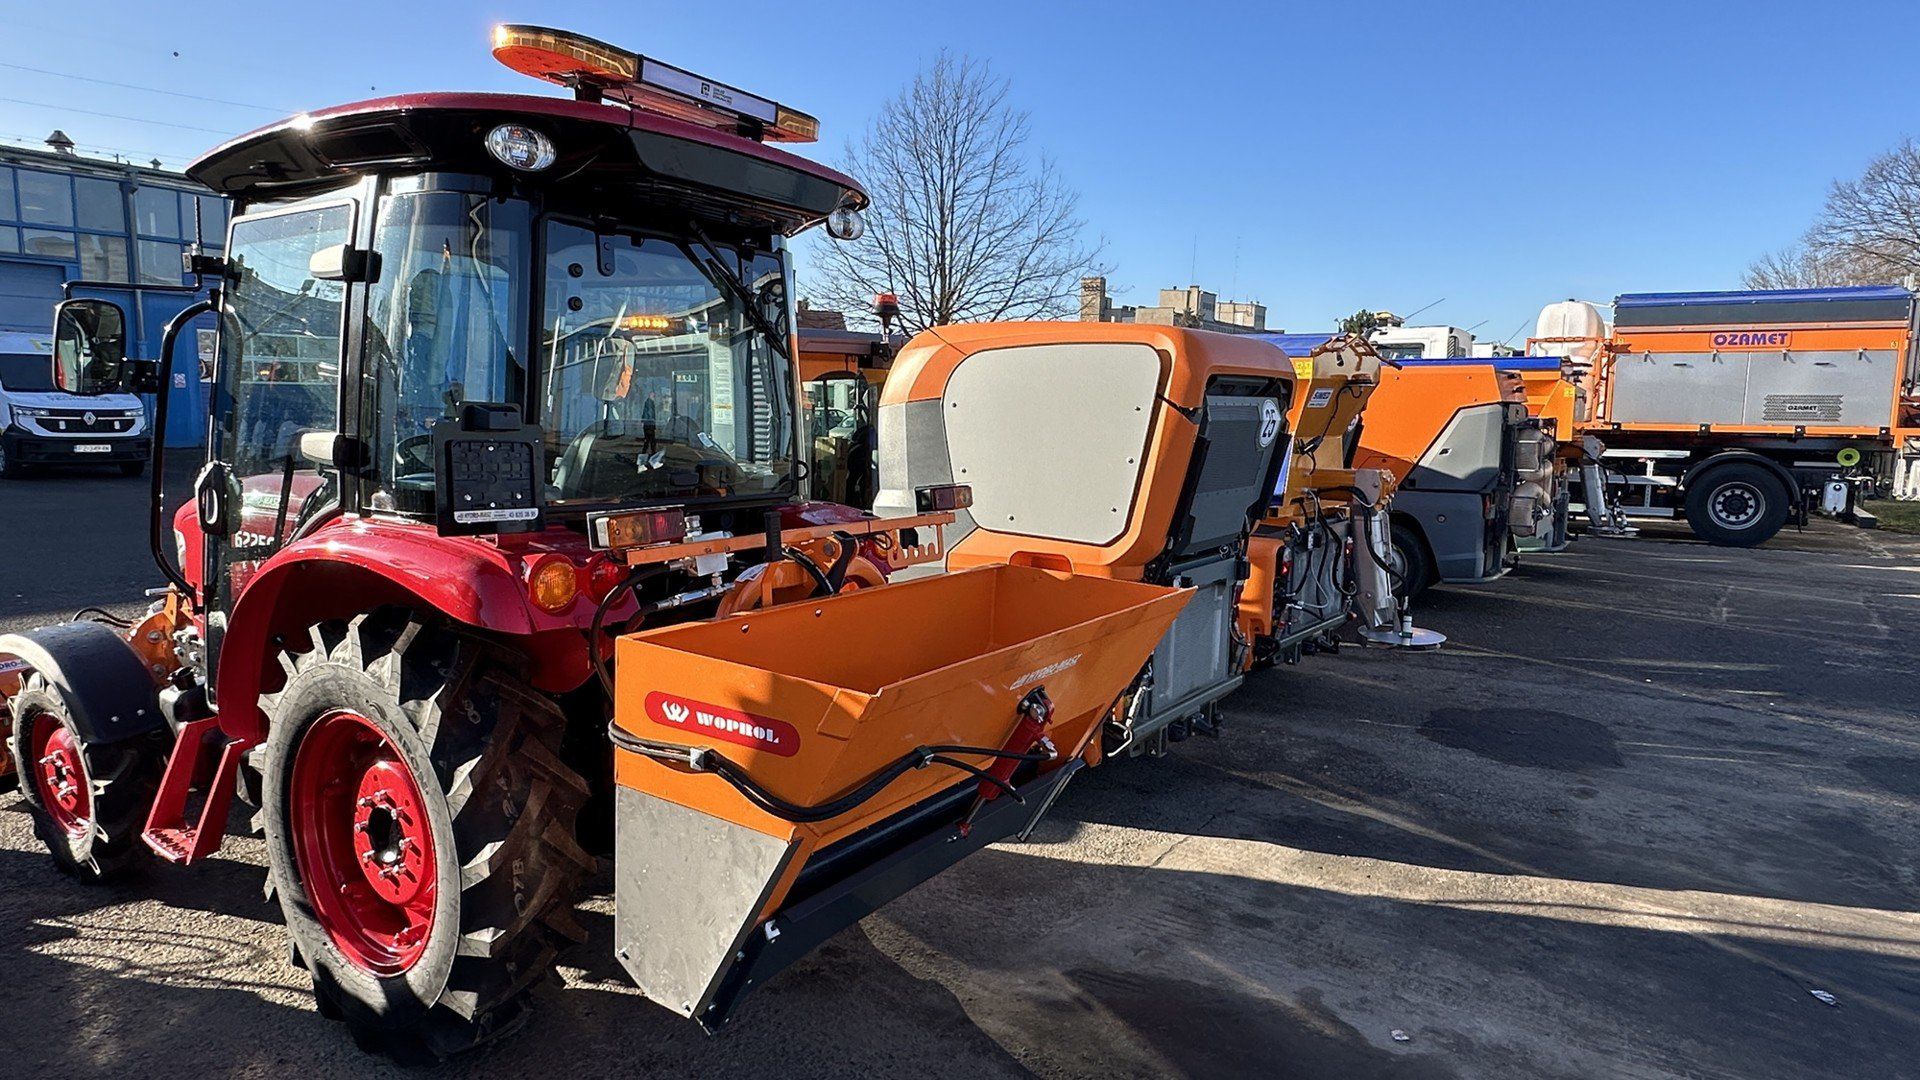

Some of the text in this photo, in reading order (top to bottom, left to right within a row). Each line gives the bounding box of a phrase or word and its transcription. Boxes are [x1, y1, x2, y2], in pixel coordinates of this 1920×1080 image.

[1714, 333, 1788, 346] OZAMET
[1262, 409, 1276, 437] 25
[695, 711, 780, 744] WOPROL
